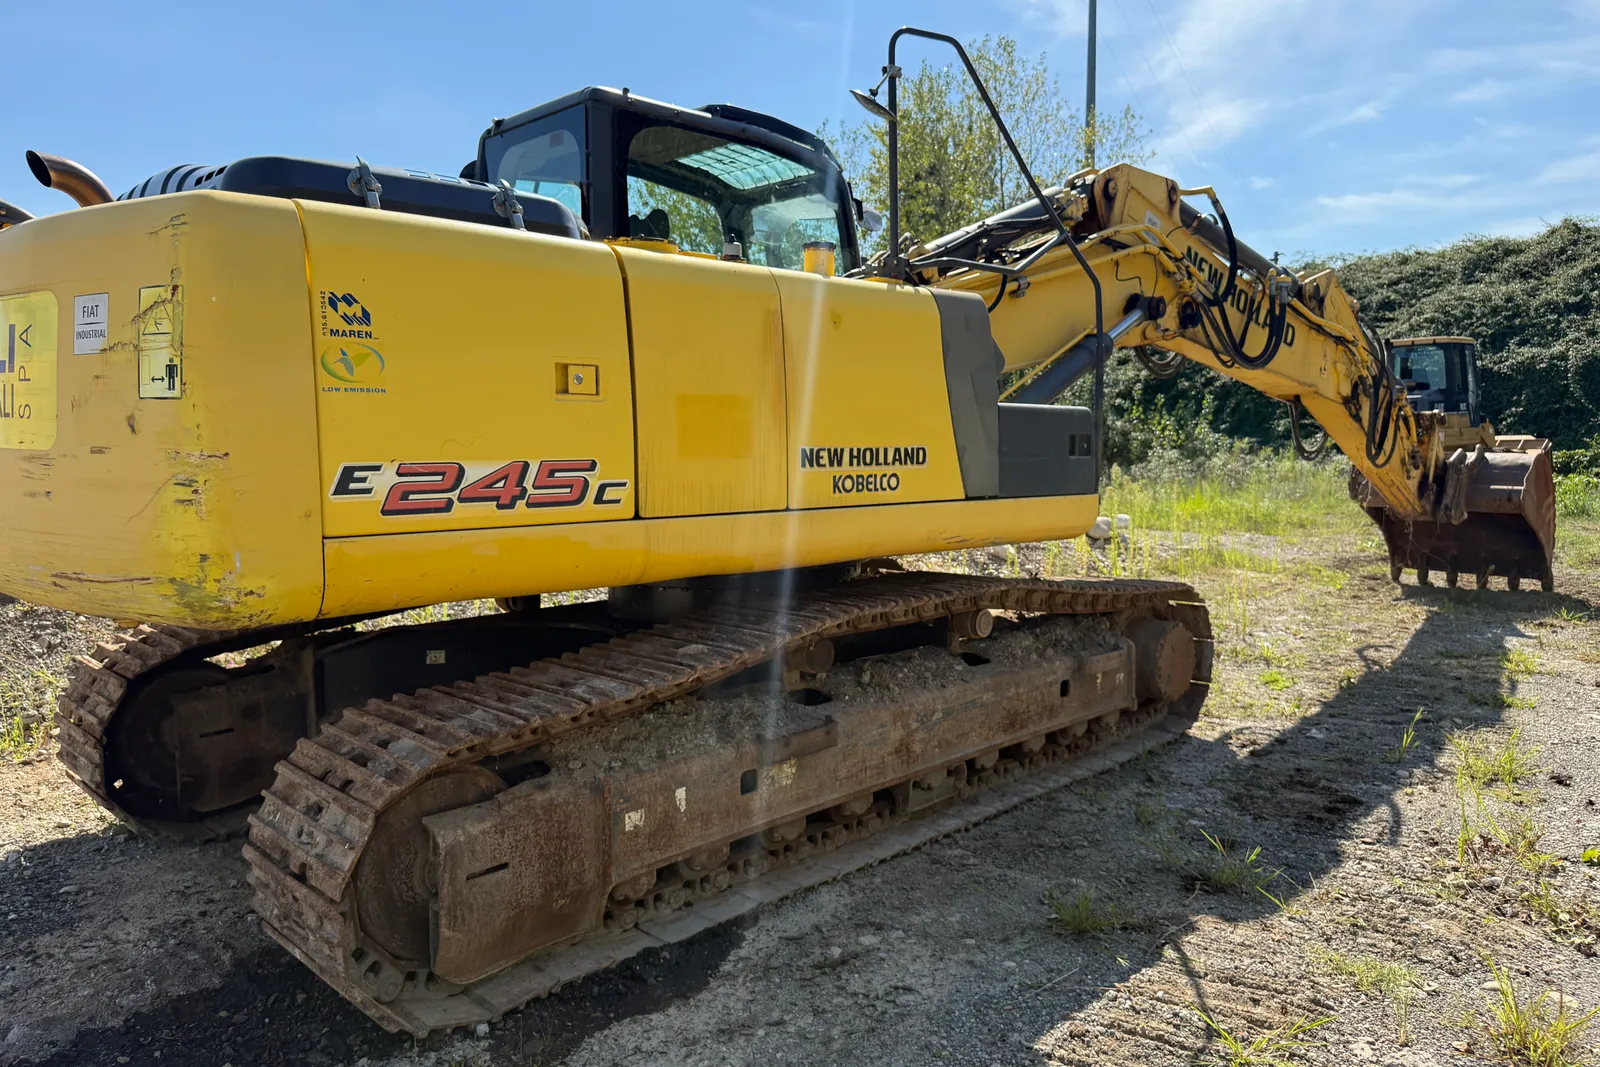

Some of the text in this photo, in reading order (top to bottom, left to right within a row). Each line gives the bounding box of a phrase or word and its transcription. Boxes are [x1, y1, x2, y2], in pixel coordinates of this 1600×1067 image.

[82, 304, 100, 319] FIAT
[75, 328, 107, 340] INDUSTRIAL
[329, 328, 373, 340] MAREN
[800, 446, 927, 468] NEW HOLLAND
[832, 472, 900, 495] KOBELCO
